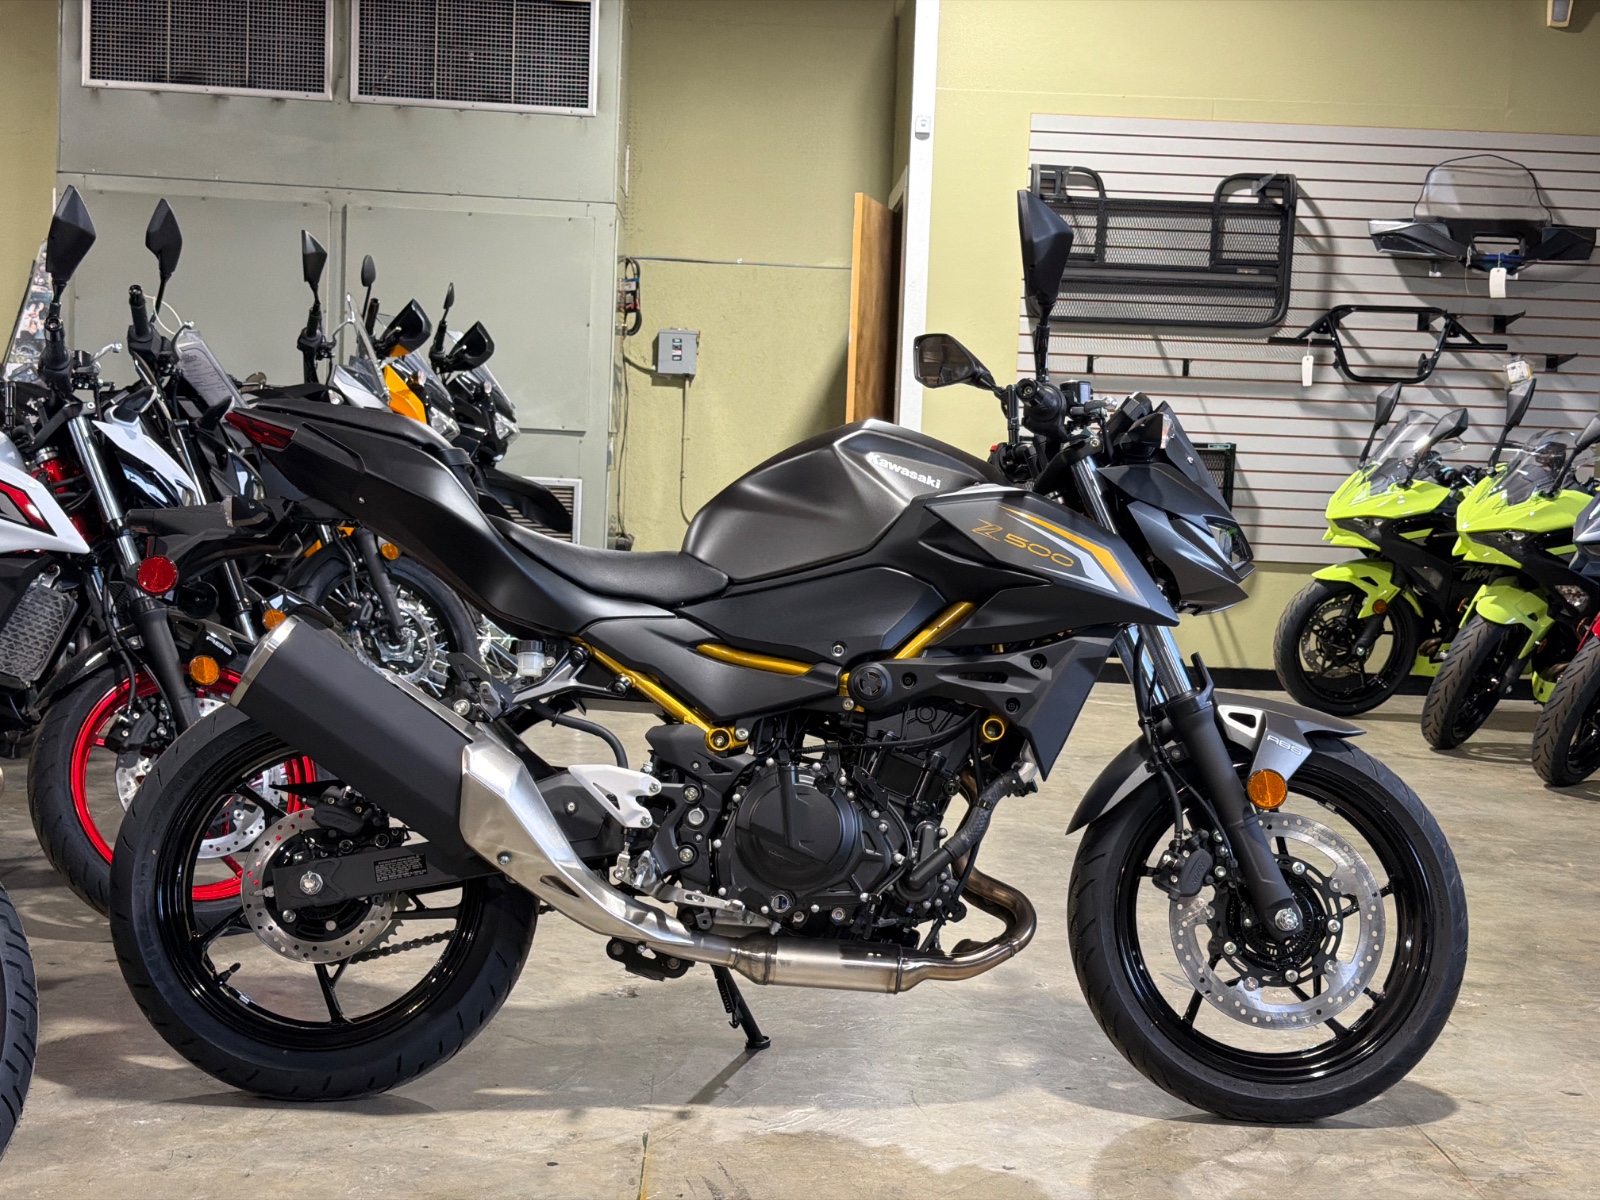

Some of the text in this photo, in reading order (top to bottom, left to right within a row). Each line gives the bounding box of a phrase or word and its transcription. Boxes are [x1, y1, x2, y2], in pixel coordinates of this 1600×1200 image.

[867, 451, 942, 489] Kawasaki
[206, 635, 232, 655] ABS
[1266, 734, 1303, 756] ABS
